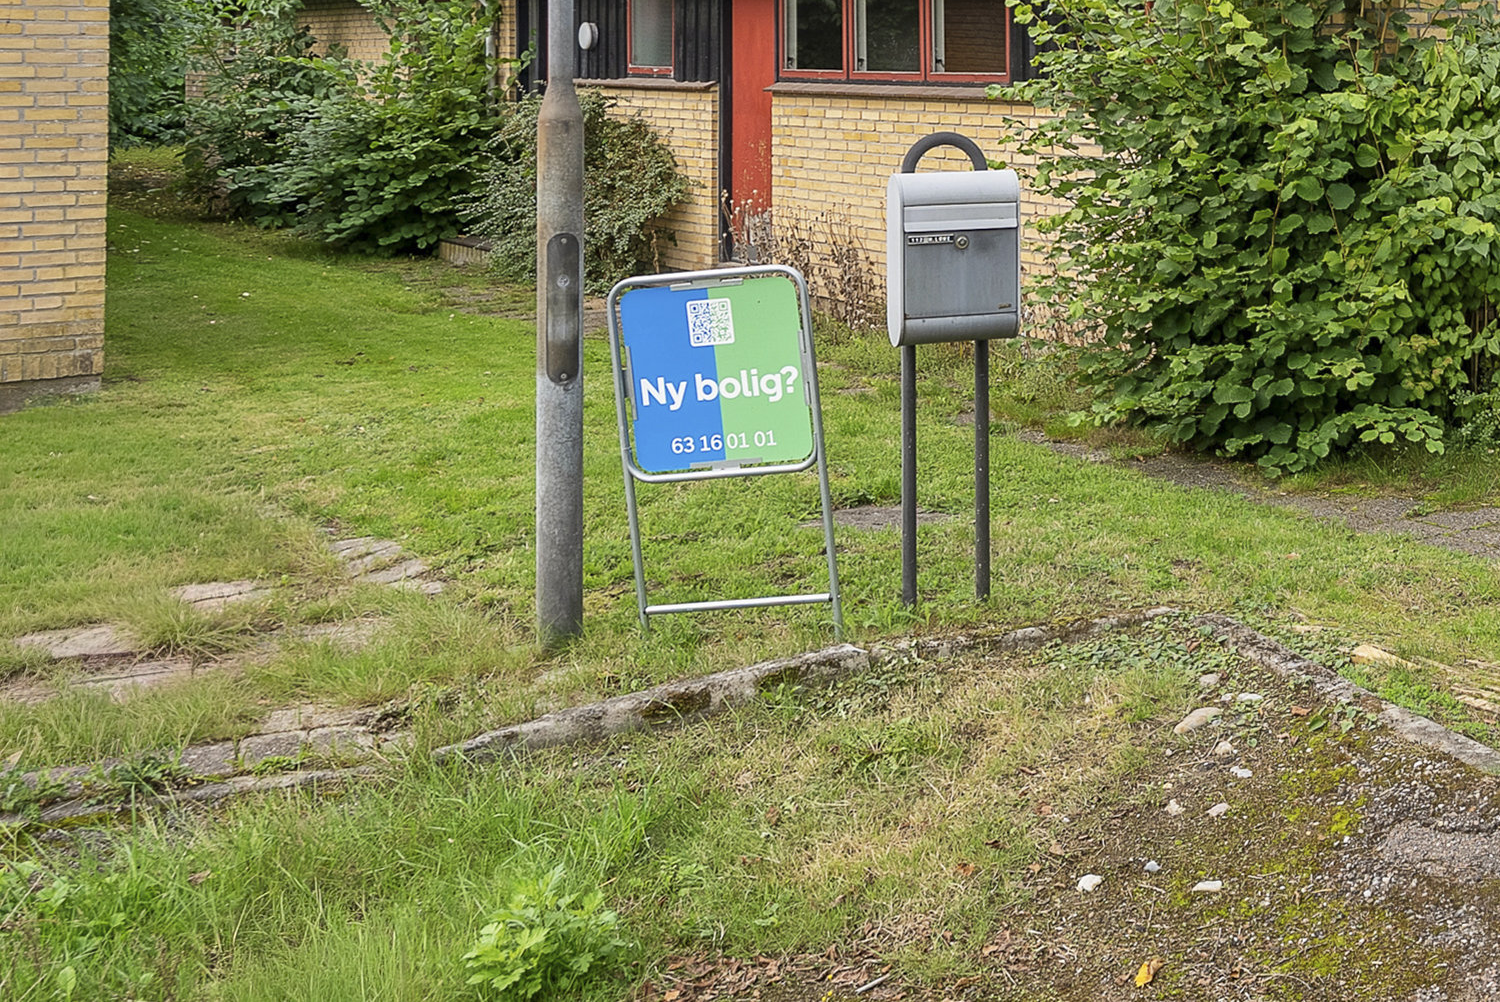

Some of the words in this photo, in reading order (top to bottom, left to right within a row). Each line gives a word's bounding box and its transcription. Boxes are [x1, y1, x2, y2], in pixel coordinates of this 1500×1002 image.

[640, 377, 687, 411] Ny
[694, 365, 799, 403] bolig?
[671, 436, 695, 454] 63
[700, 434, 723, 452] 16
[726, 432, 750, 449] 01
[754, 430, 777, 447] 01
